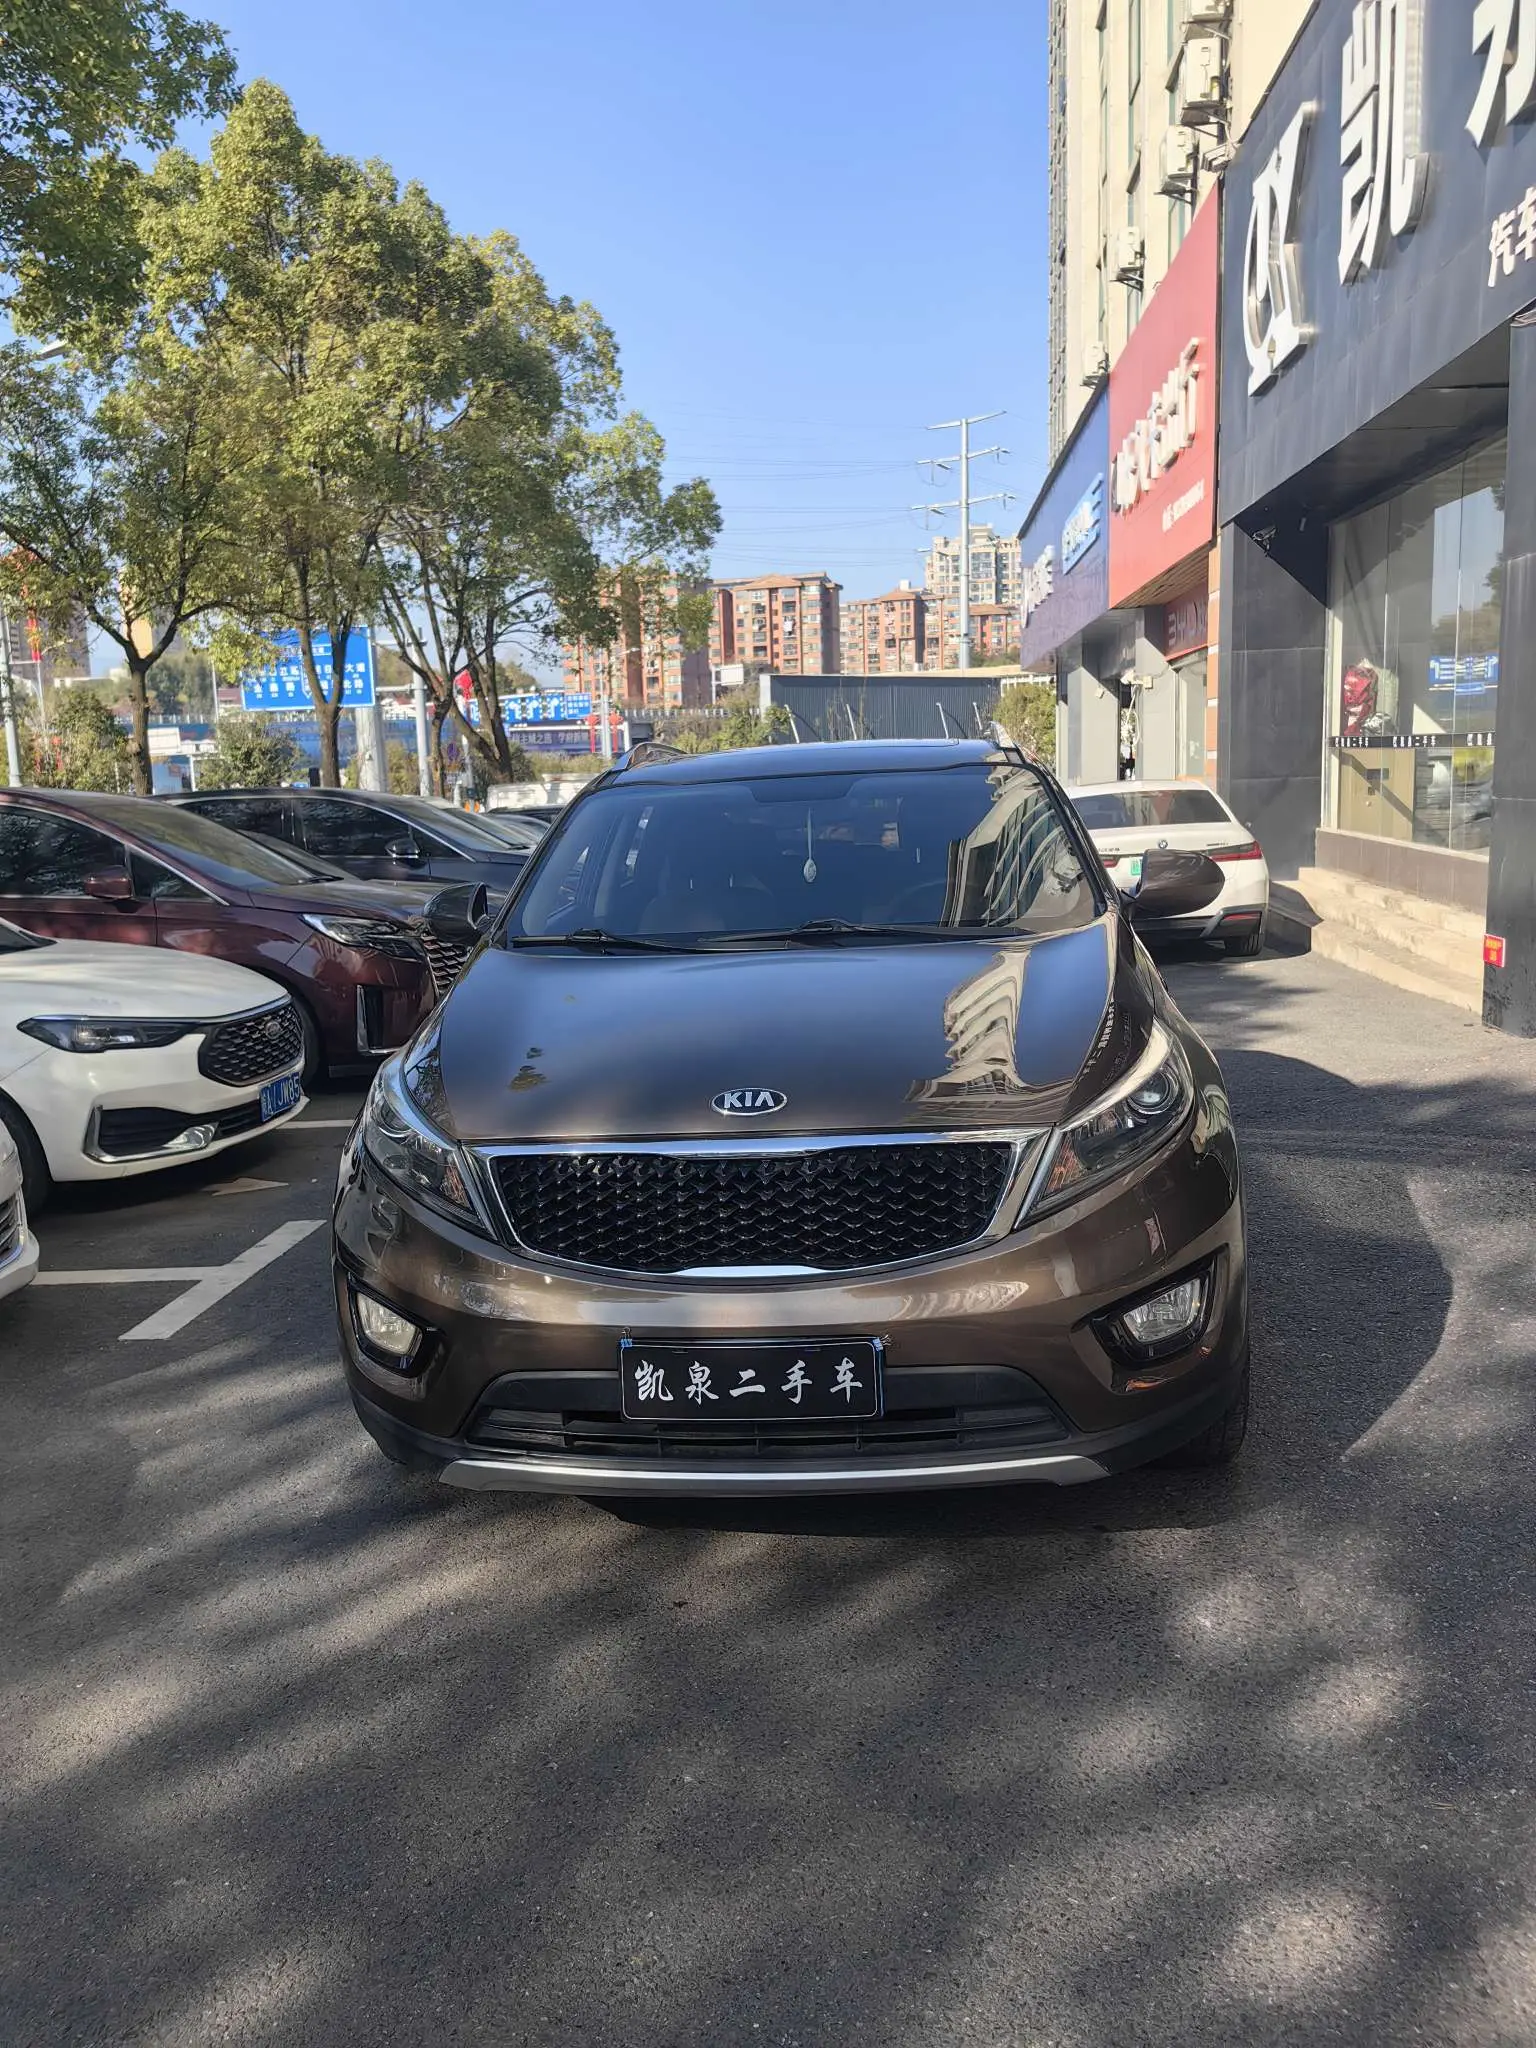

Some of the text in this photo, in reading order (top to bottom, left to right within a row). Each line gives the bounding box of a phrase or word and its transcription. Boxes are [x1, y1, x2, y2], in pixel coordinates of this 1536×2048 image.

[722, 1090, 777, 1109] KIA
[634, 1357, 864, 1405] 凯泉二手车
